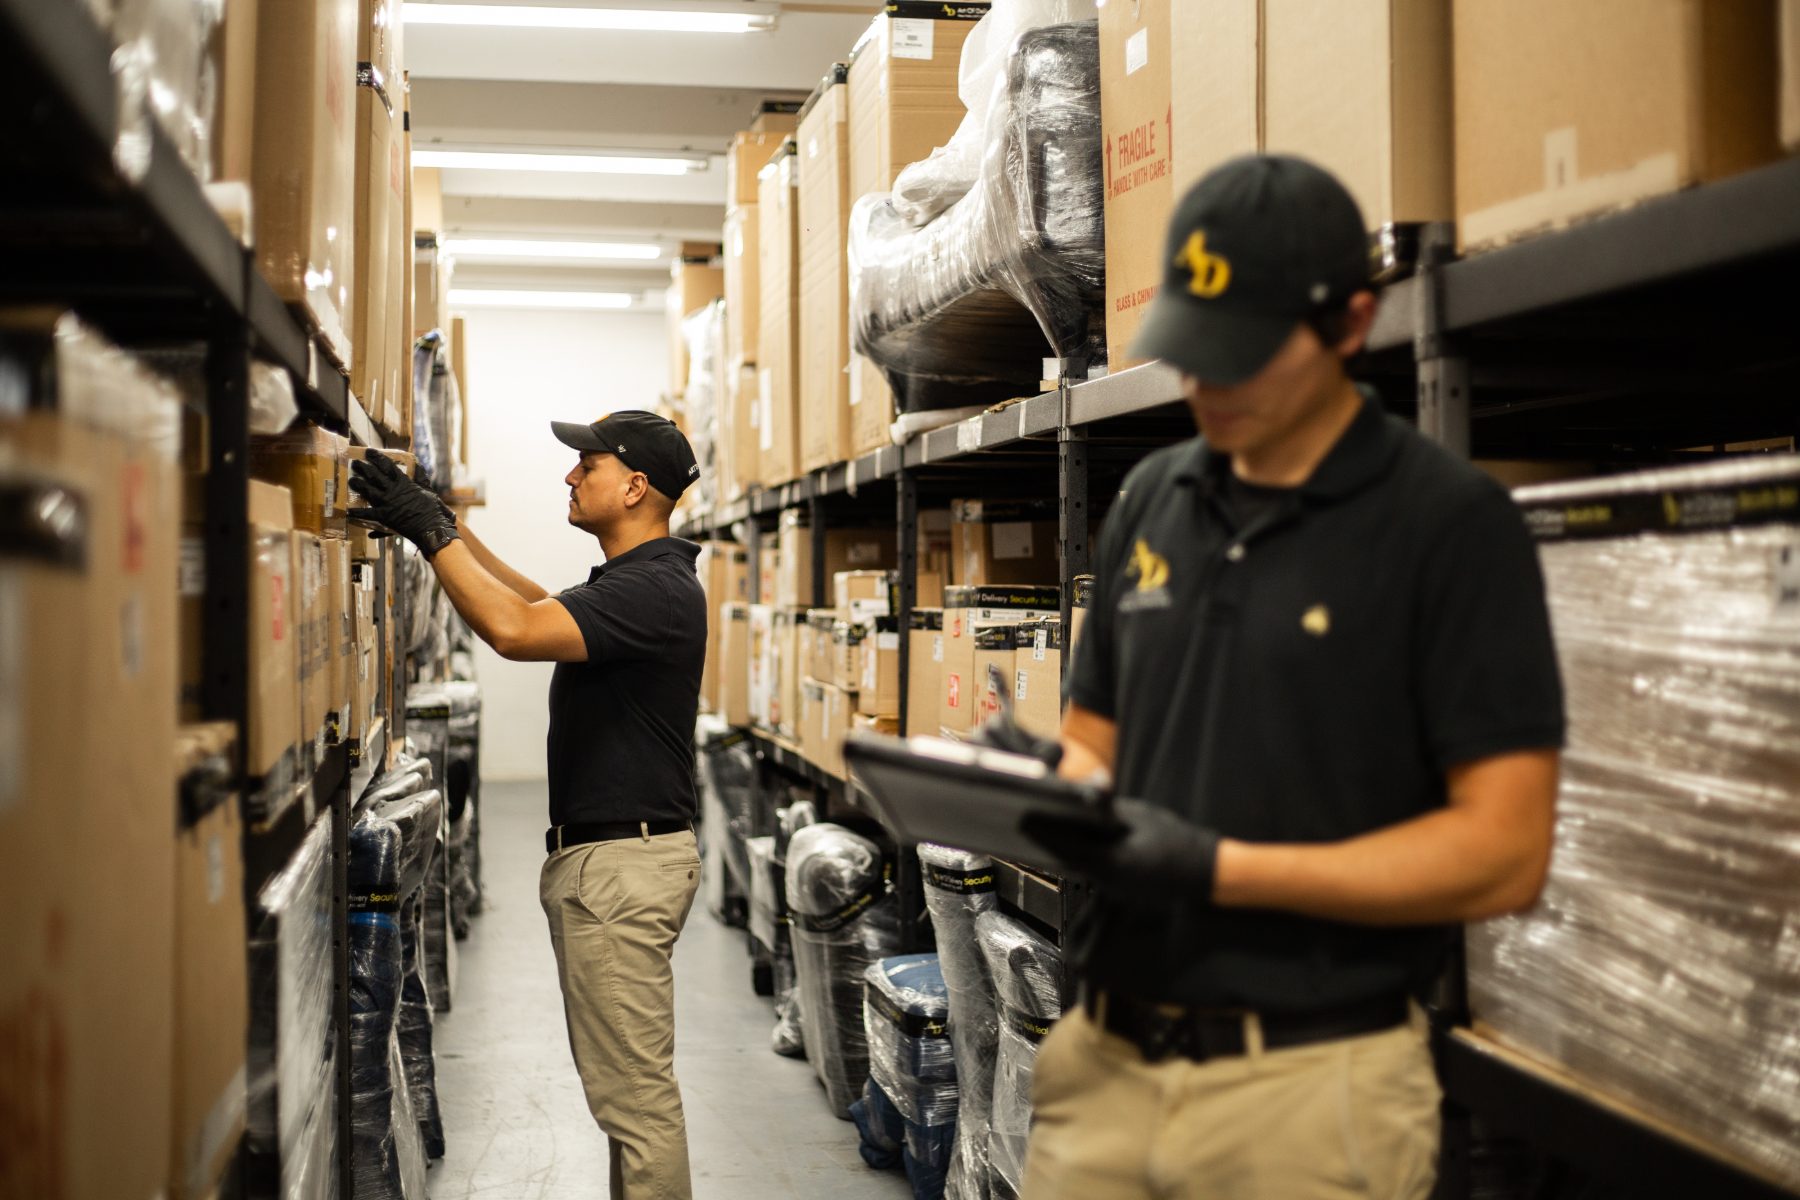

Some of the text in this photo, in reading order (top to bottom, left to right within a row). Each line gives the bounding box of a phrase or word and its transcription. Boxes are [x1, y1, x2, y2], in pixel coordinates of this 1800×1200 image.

[1118, 120, 1156, 170] FRAGILE
[1114, 172, 1132, 198] HANDLE
[1133, 166, 1148, 188] WITH
[1149, 158, 1166, 181] CARE
[981, 593, 1008, 604] Delivery
[1009, 595, 1039, 605] Security
